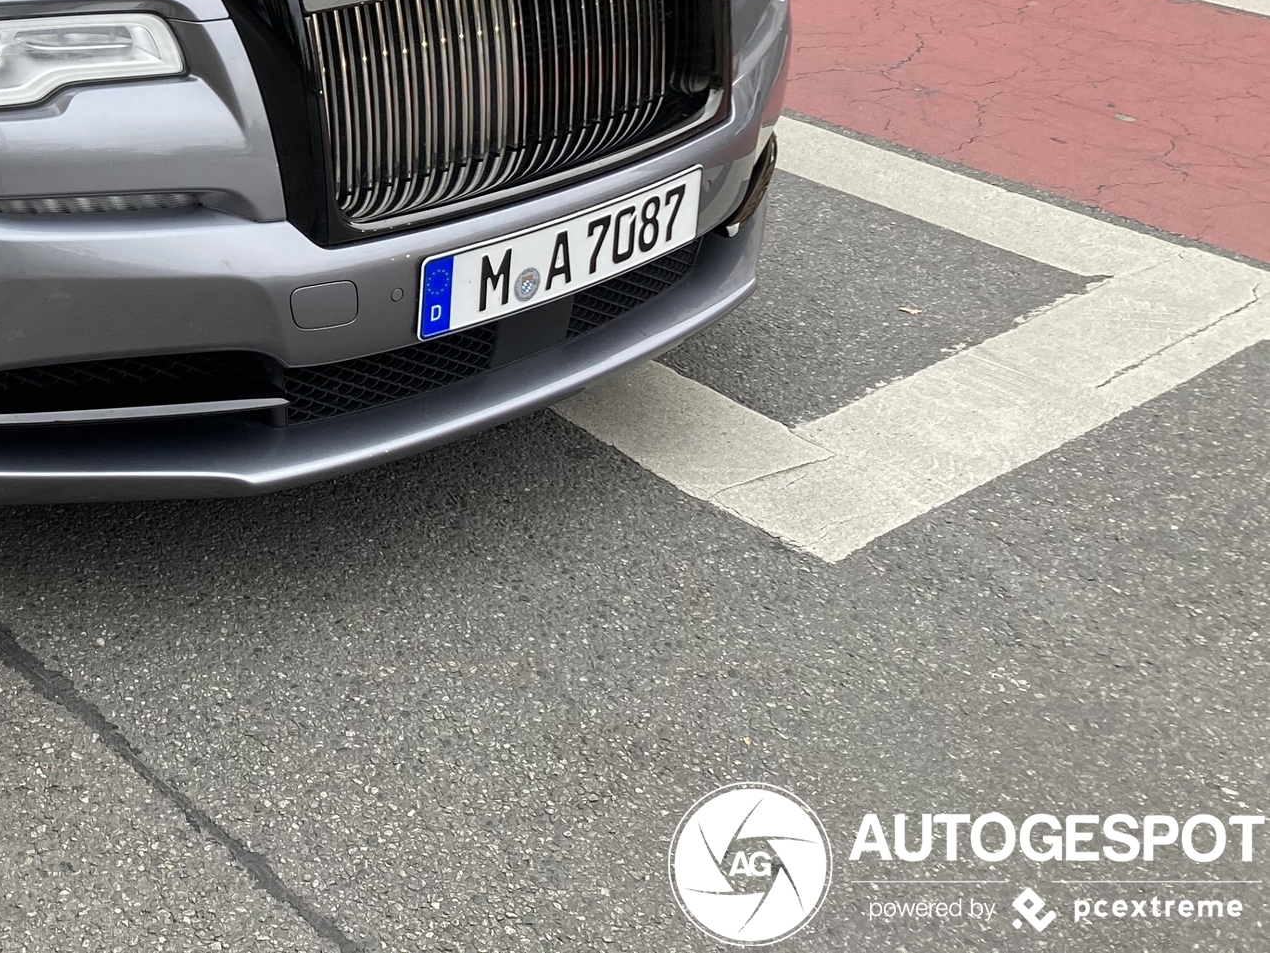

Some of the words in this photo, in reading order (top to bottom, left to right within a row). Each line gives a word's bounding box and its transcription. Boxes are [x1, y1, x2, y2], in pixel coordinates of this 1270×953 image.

[478, 248, 513, 312] M
[545, 230, 572, 291] A
[587, 183, 687, 275] 7087
[430, 304, 442, 322] D
